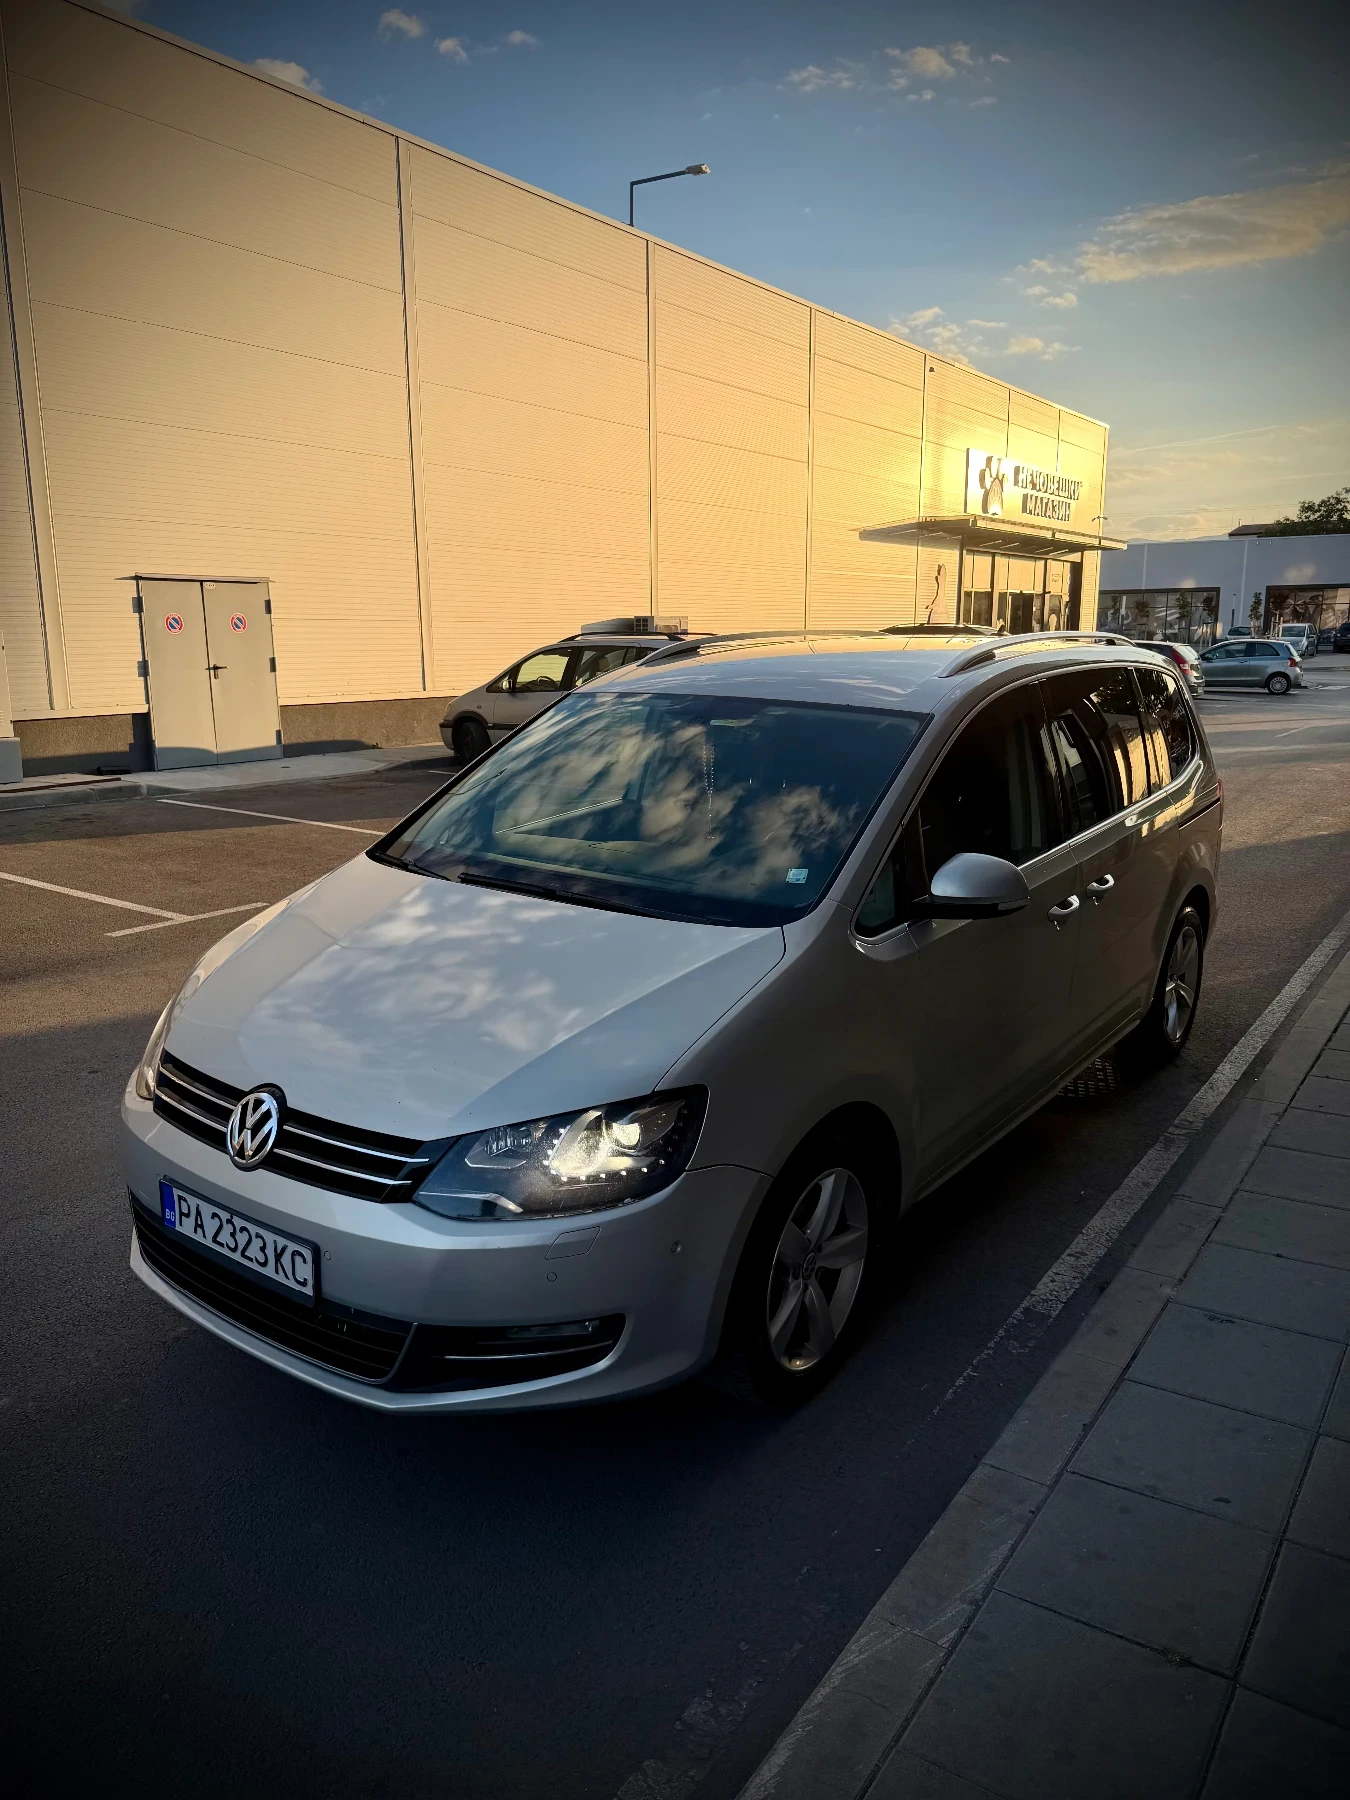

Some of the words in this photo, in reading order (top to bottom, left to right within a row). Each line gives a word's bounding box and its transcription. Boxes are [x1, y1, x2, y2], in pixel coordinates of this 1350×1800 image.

[1015, 466, 1080, 500] НЕЧОВЕШКИ
[1024, 493, 1071, 521] МАГАЗИН
[165, 1208, 175, 1222] BG
